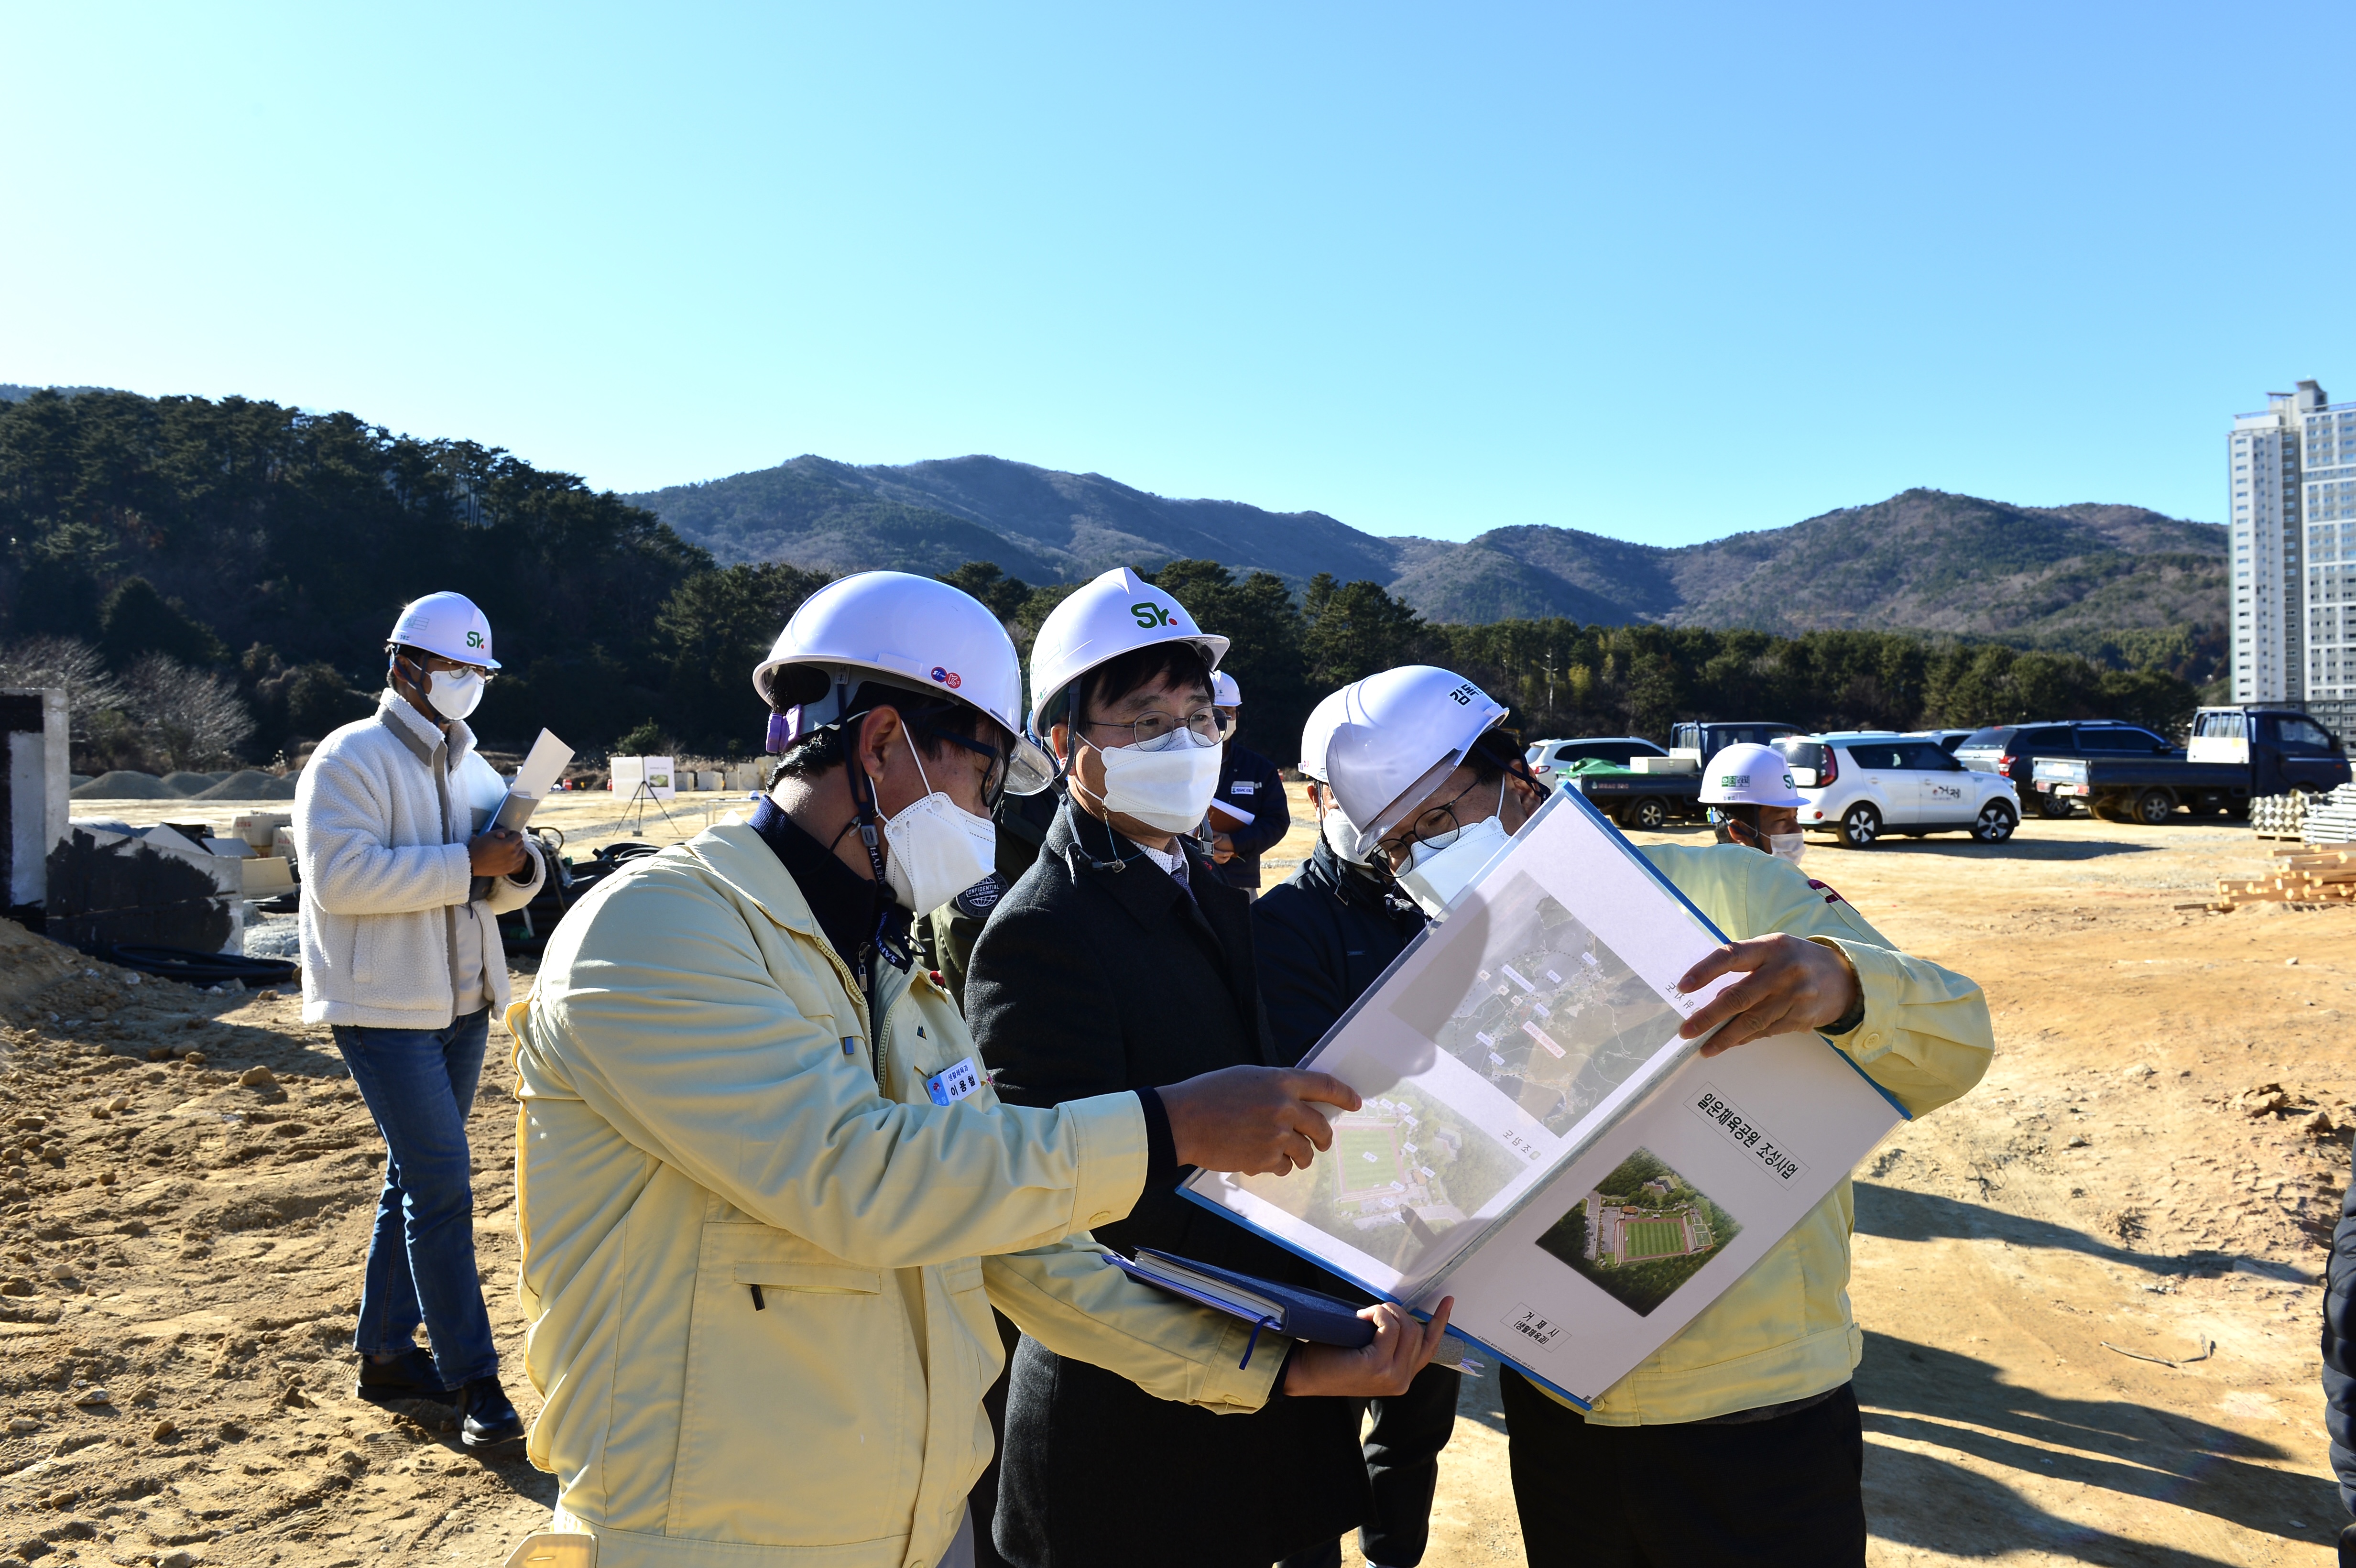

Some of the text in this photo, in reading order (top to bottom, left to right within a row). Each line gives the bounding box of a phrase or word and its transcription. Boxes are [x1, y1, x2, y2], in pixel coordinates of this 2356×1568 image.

[965, 884, 1000, 897] CONFIDENTIAL
[948, 1065, 969, 1081] 생활체육과
[1698, 1092, 1798, 1179] 일운체육공원 조성사업
[1513, 1320, 1549, 1345] (생활체육과)
